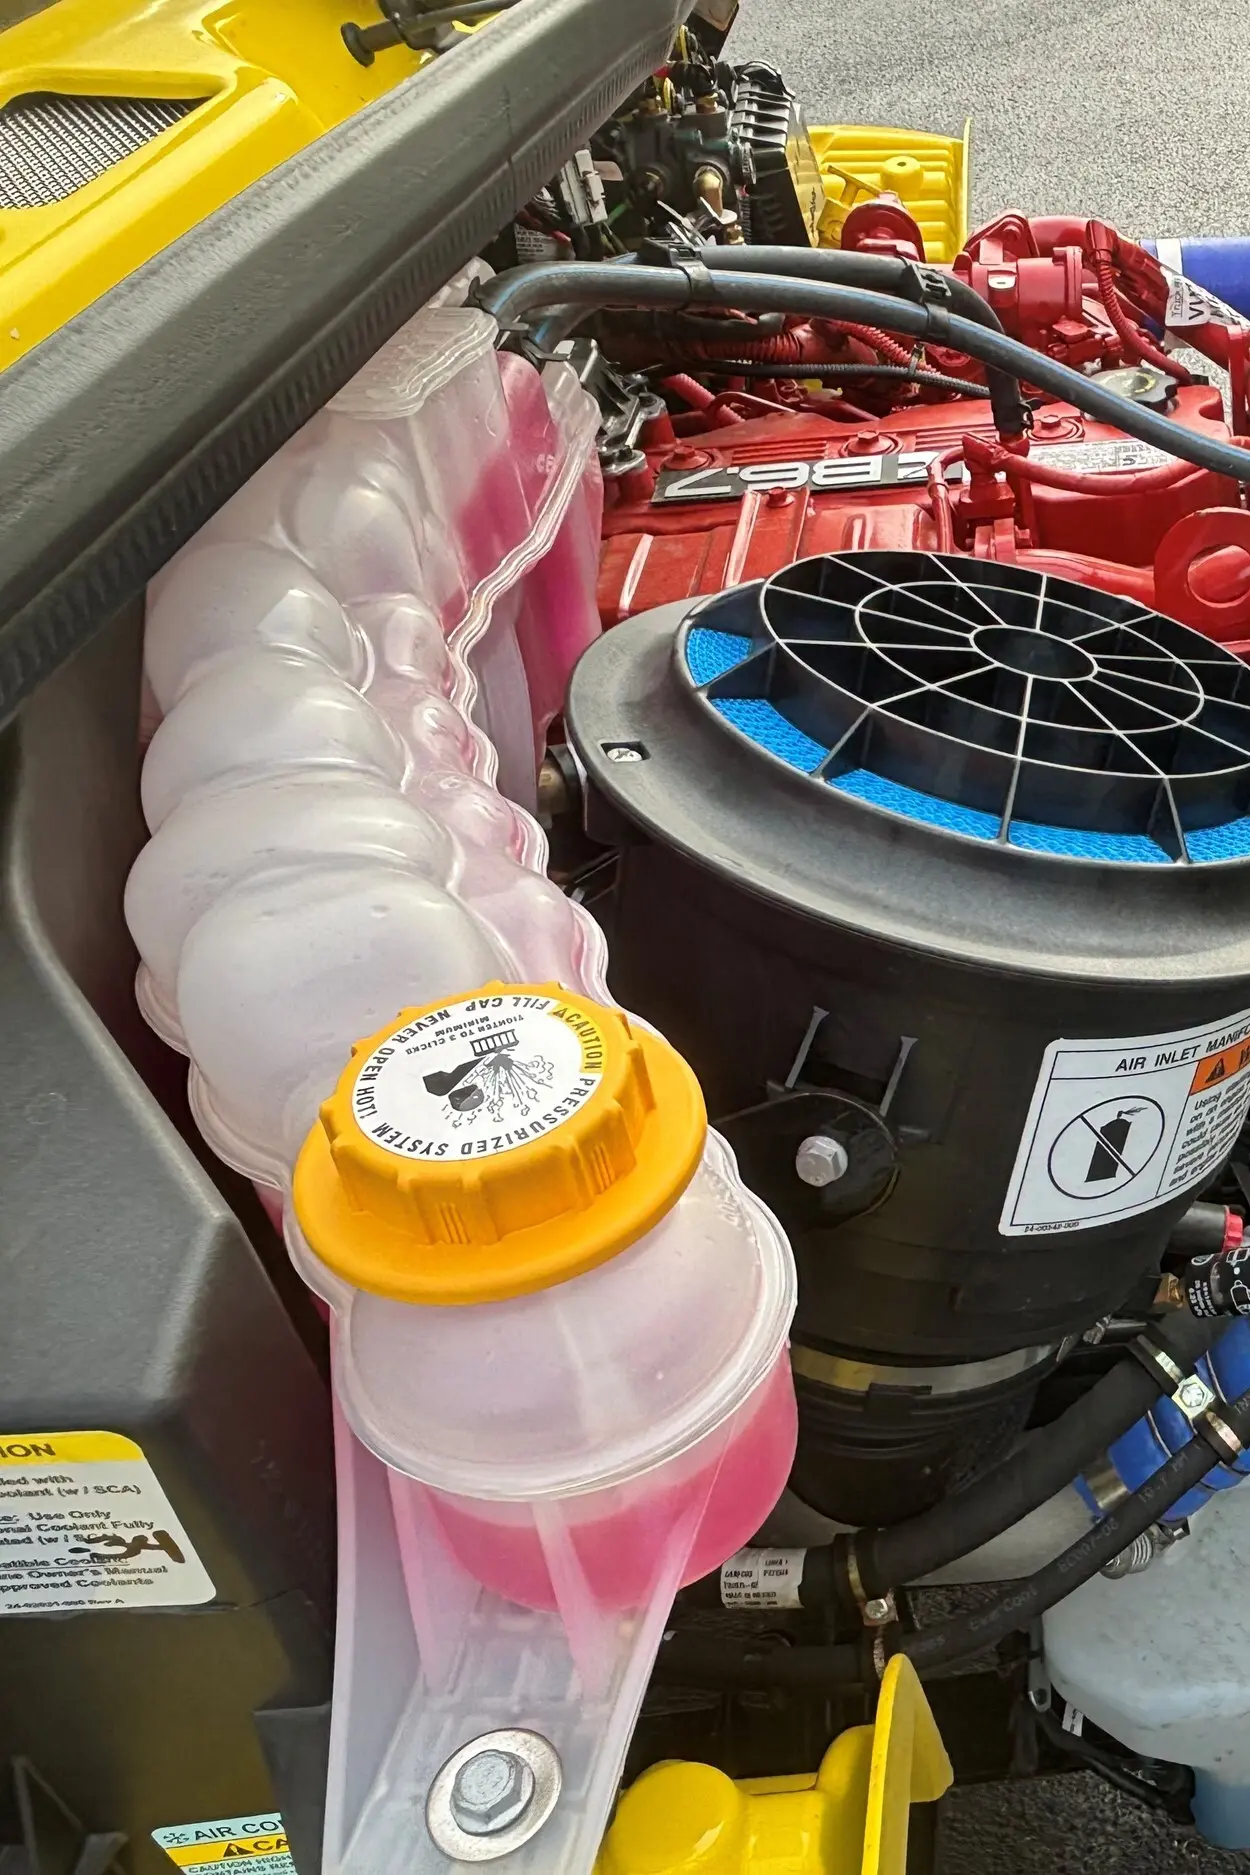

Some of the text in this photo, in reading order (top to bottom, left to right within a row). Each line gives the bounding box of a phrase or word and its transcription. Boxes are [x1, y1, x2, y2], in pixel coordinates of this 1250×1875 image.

[405, 1014, 525, 1056] TIGHTEN TO 3 CLICKS
[434, 1015, 491, 1037] MINIMUM
[564, 1012, 603, 1070] CAUTION
[356, 996, 551, 1120] FILL CAP NEVER OPEN HOT!
[1115, 1056, 1146, 1073] AIR
[1154, 1043, 1201, 1068] INLET
[371, 1076, 598, 1157] PRESSURIZED SYSTEM
[32, 1475, 74, 1485] with
[93, 1485, 142, 1495] SCA)
[27, 1511, 65, 1521] Use
[68, 1509, 111, 1520] Only
[37, 1522, 109, 1532] Coolant
[111, 1520, 155, 1531] Fully
[194, 1825, 237, 1841] AIR
